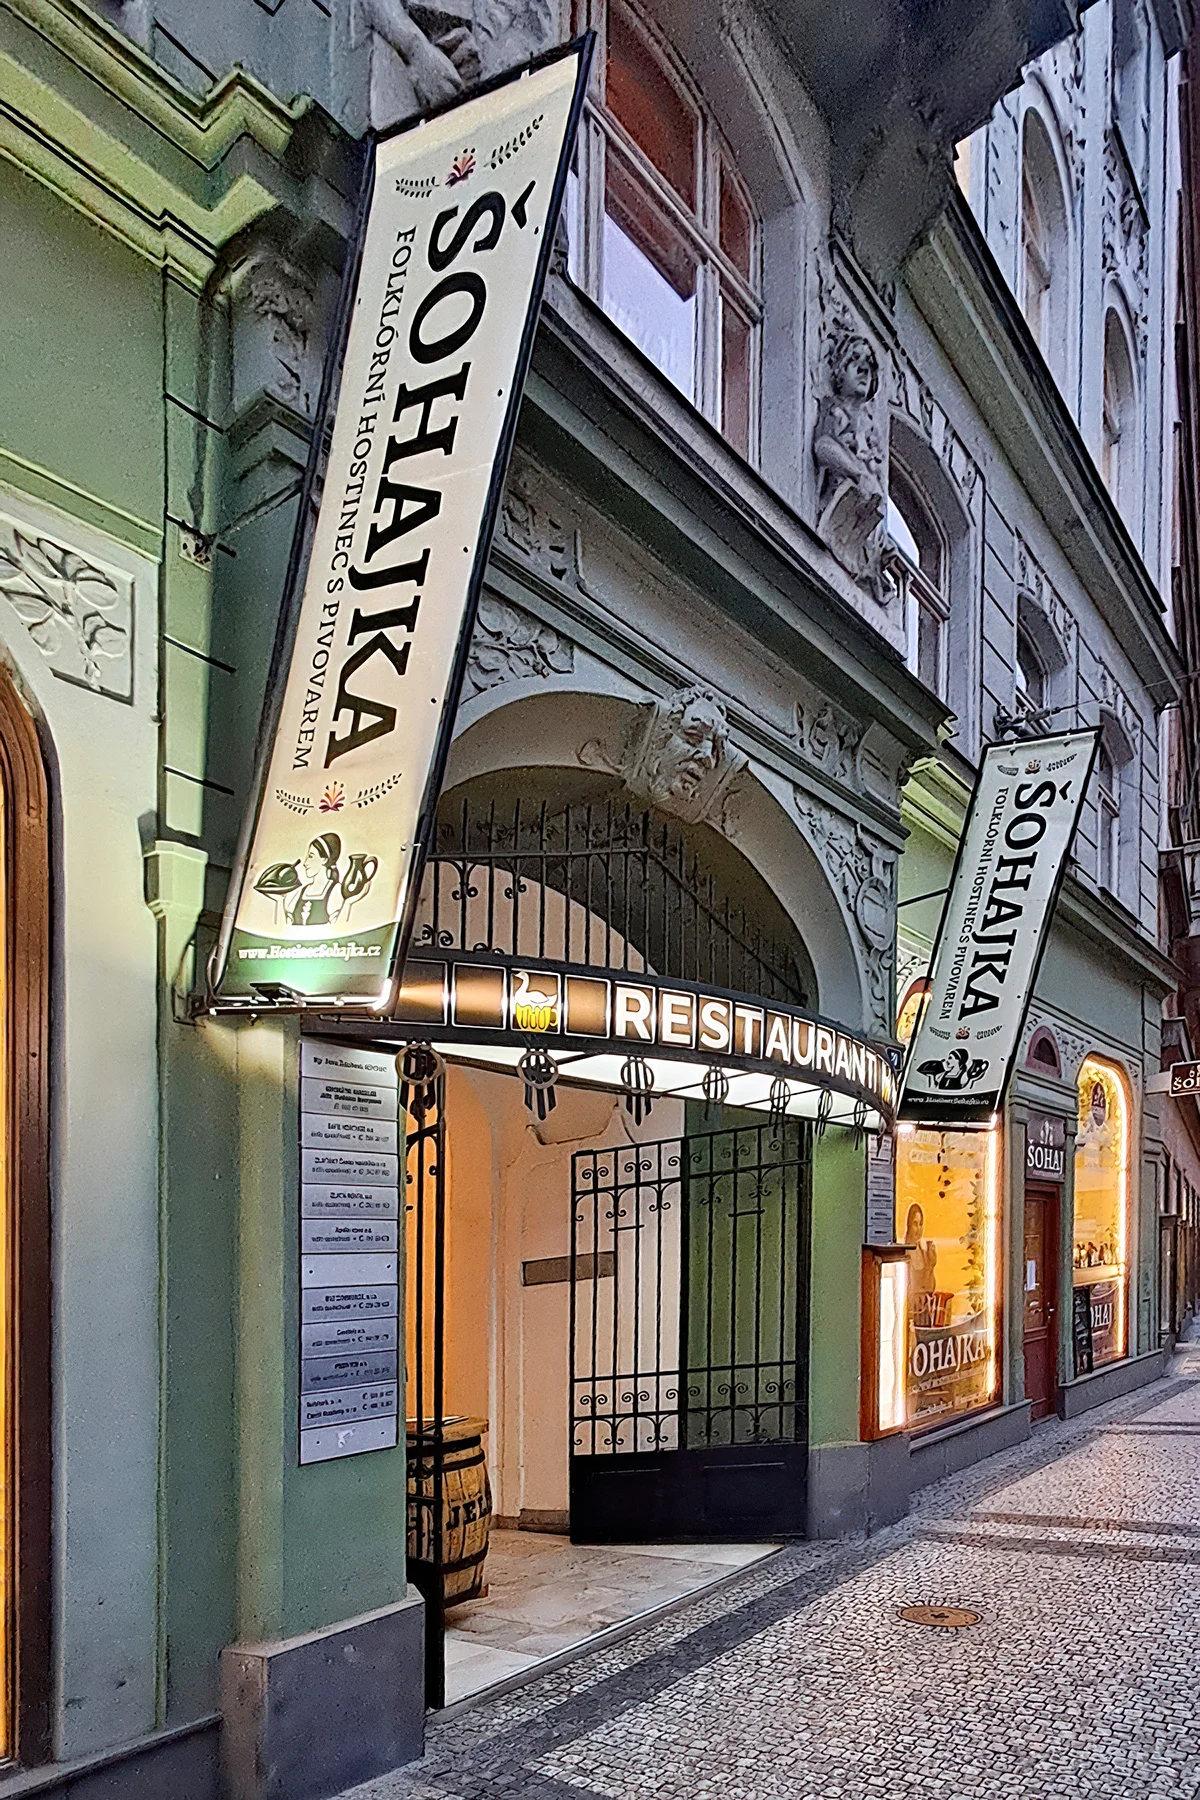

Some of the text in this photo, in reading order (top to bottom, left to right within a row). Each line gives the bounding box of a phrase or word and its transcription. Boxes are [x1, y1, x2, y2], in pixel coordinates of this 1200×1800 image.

[362, 225, 417, 408] FOLKLÓRNÍ
[323, 180, 536, 770] ŠOHAJKA
[331, 412, 378, 572] HOSTINEC
[292, 600, 340, 771] PIVOVAREM
[957, 779, 1072, 1021] ŠOHAJKA
[962, 866, 989, 934] HOSTINEC
[614, 985, 876, 1090] RESTAURANT
[939, 946, 968, 1020] PIVOVAREM
[1172, 1076, 1200, 1091] ŠO
[908, 1333, 986, 1378] OHAJKA
